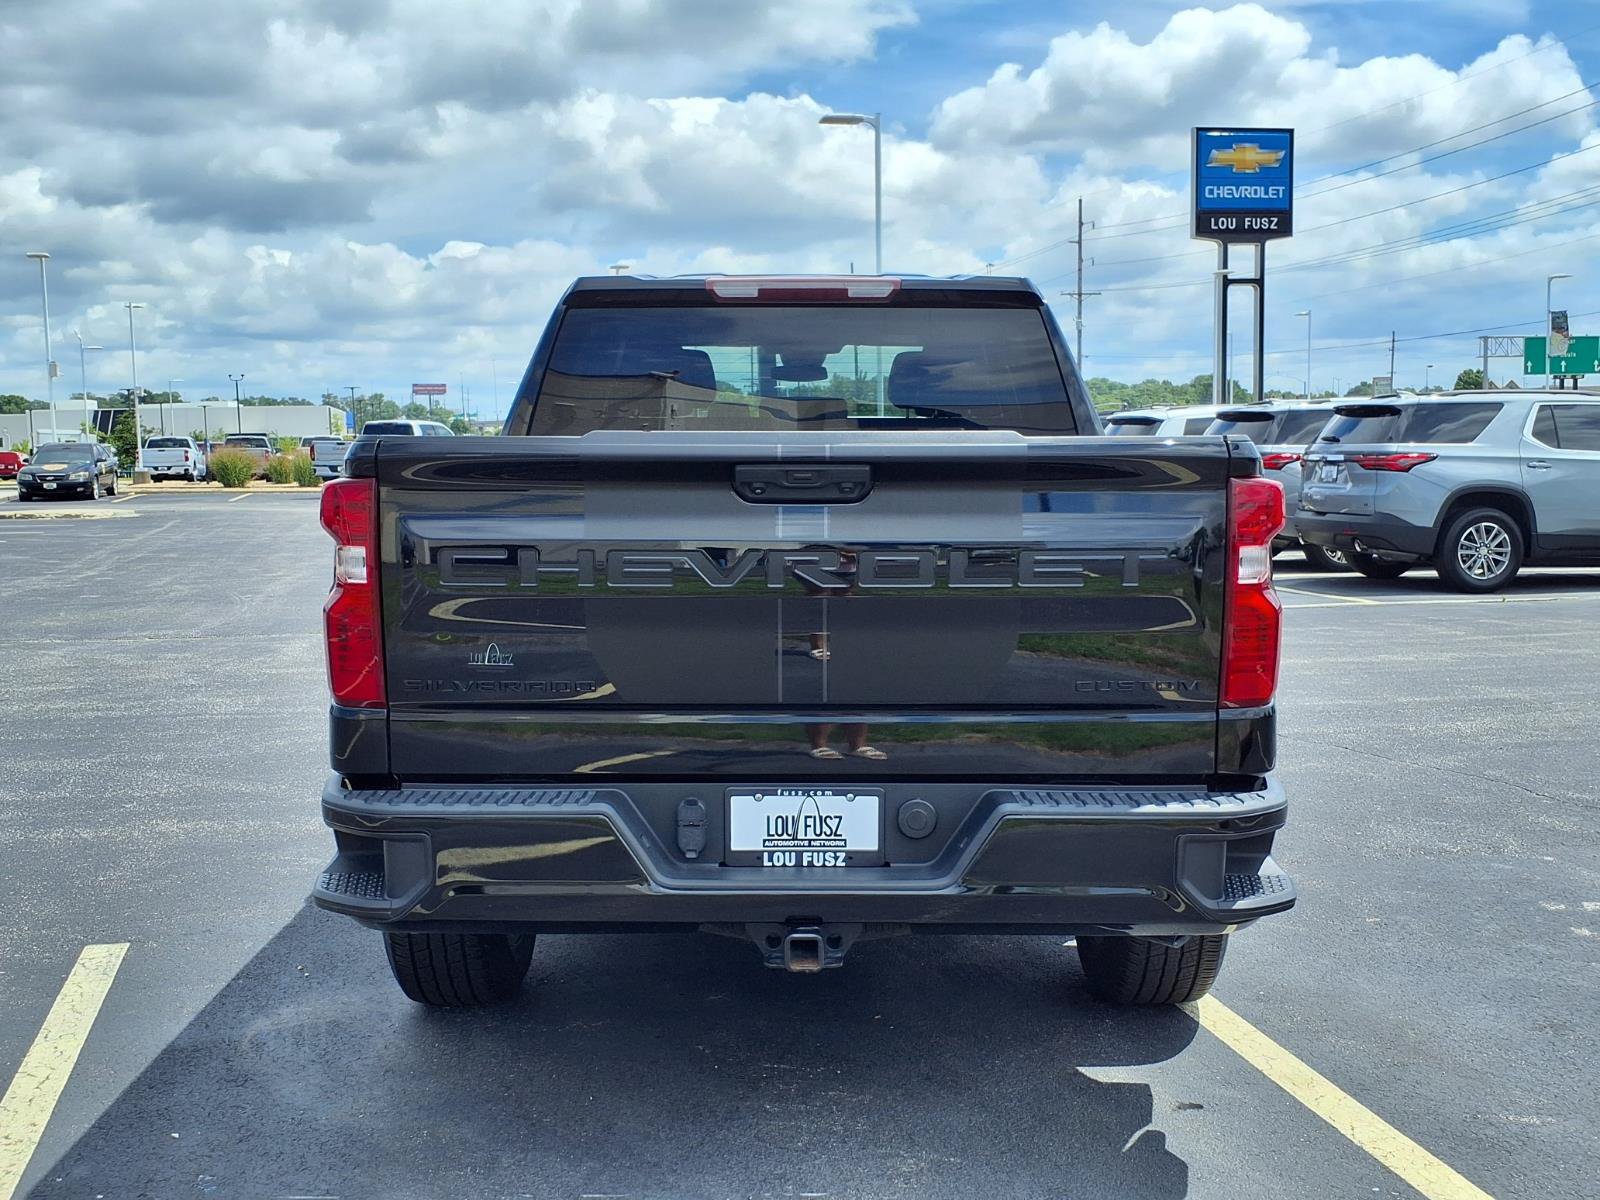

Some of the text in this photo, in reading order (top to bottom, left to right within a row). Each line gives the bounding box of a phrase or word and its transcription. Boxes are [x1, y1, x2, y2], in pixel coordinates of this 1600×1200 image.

[1205, 186, 1285, 199] CHEVROLET
[1210, 217, 1279, 230] LOU FUSZ
[438, 549, 1168, 588] CHEVROLET
[403, 679, 597, 693] SILVERADO
[1074, 679, 1201, 692] CUSTOM
[777, 788, 833, 796] fusz.com
[766, 815, 843, 837] LOU FUSZ
[763, 851, 846, 867] LOU FUSZ
